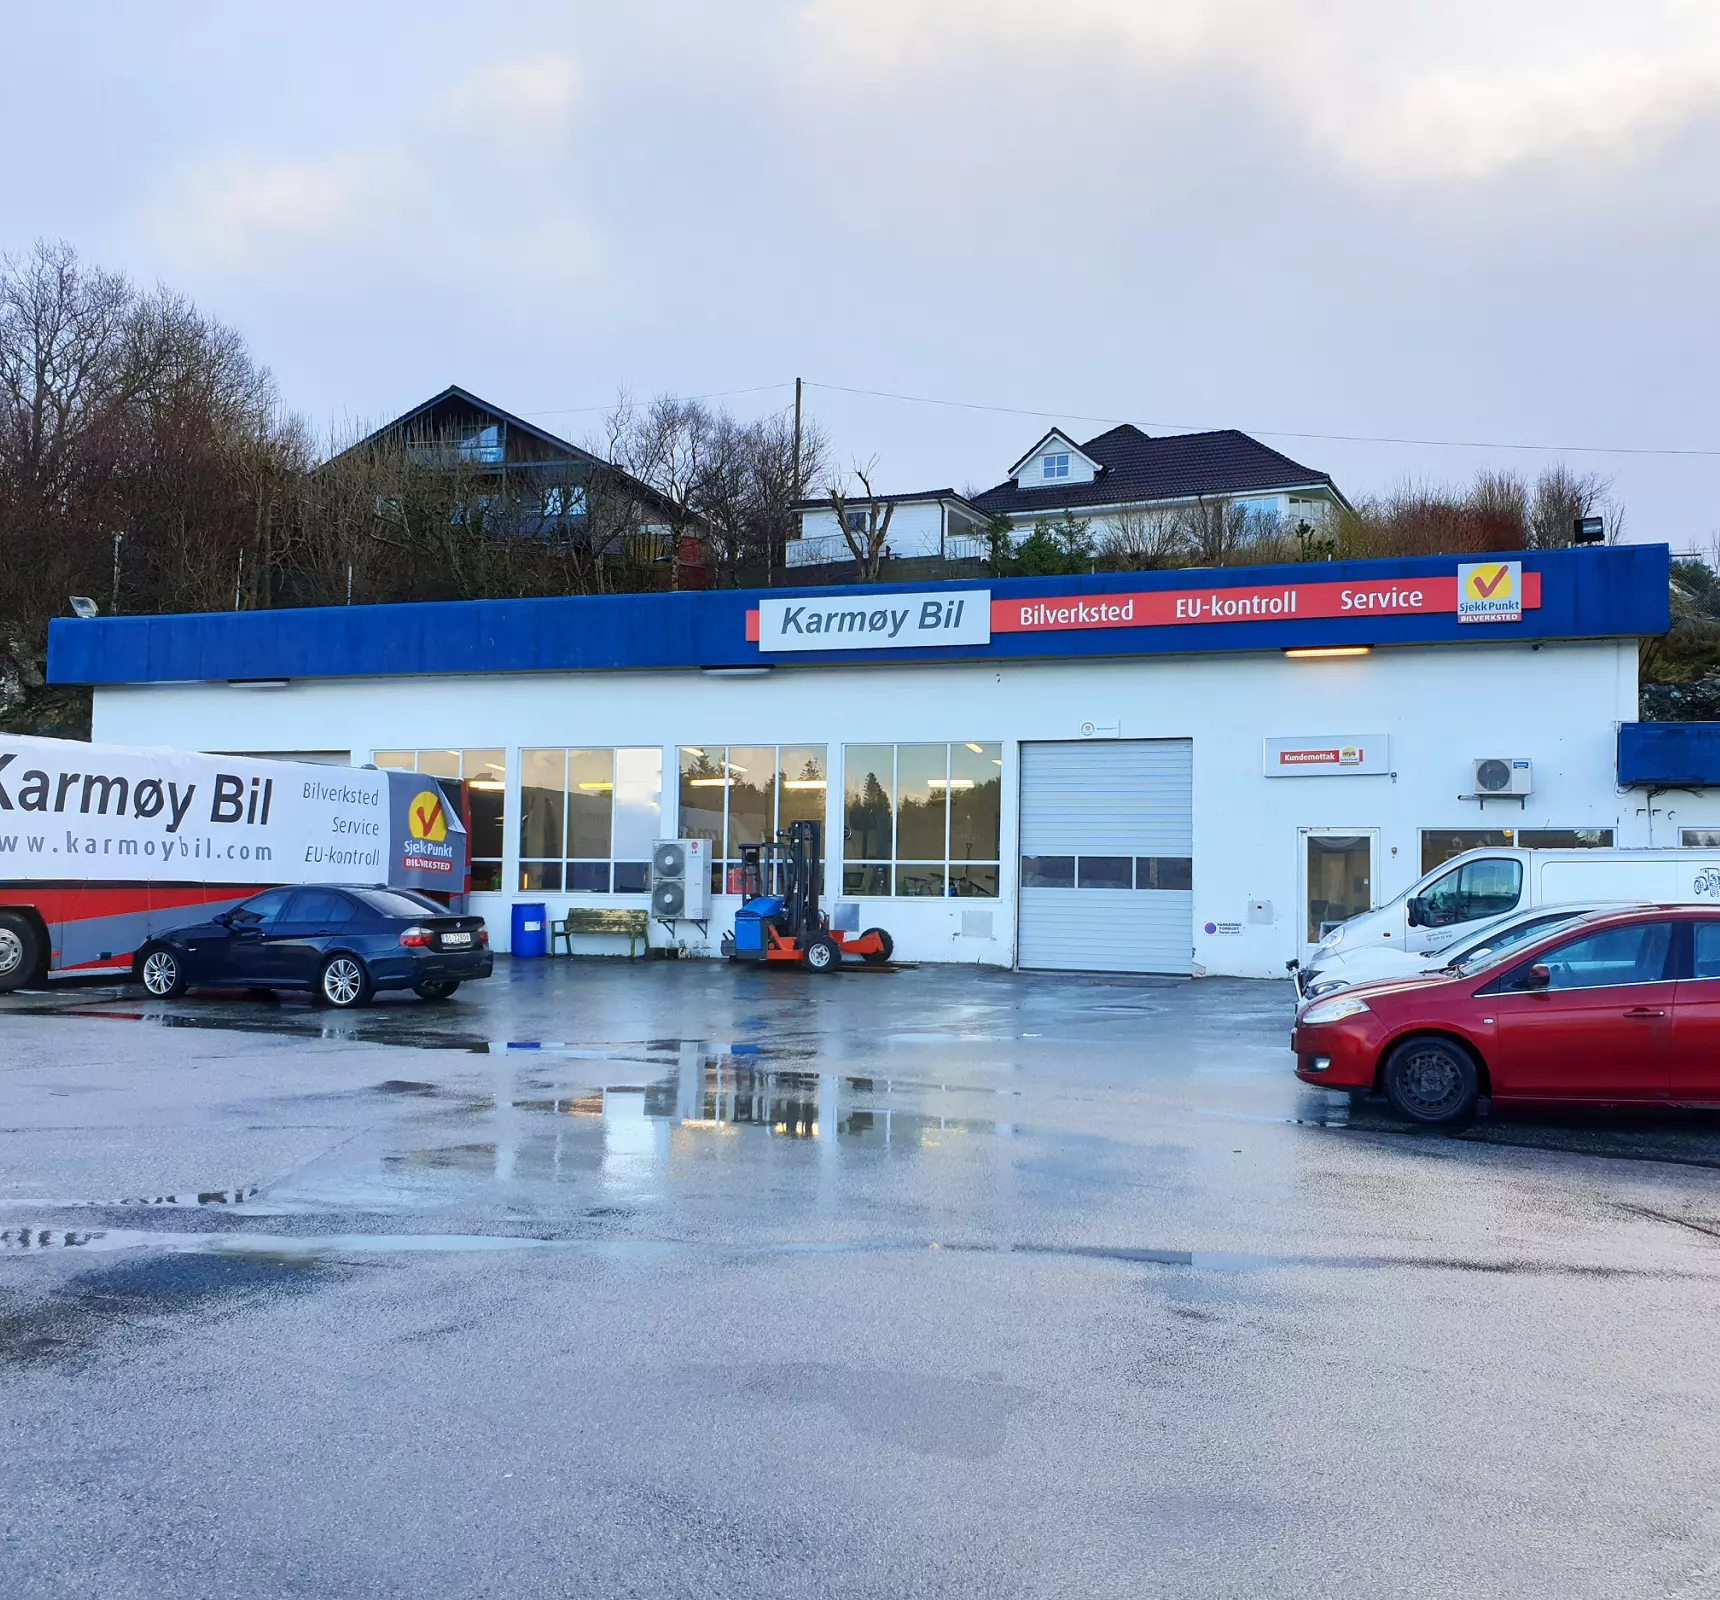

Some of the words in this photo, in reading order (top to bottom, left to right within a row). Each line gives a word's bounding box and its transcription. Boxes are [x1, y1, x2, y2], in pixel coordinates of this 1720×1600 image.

[1020, 599, 1133, 626] Bilverksted
[1176, 590, 1296, 618] EU-kontroll
[1341, 586, 1423, 610] Service
[781, 606, 909, 638] Karmøy
[918, 600, 965, 630] Bil
[1460, 614, 1518, 622] BILVERKSTED
[1284, 752, 1335, 761] Kundemottak
[210, 773, 273, 825] Bil
[303, 782, 379, 806] Bilverksted
[332, 816, 379, 836] Service
[304, 845, 380, 866] EU-kontroll
